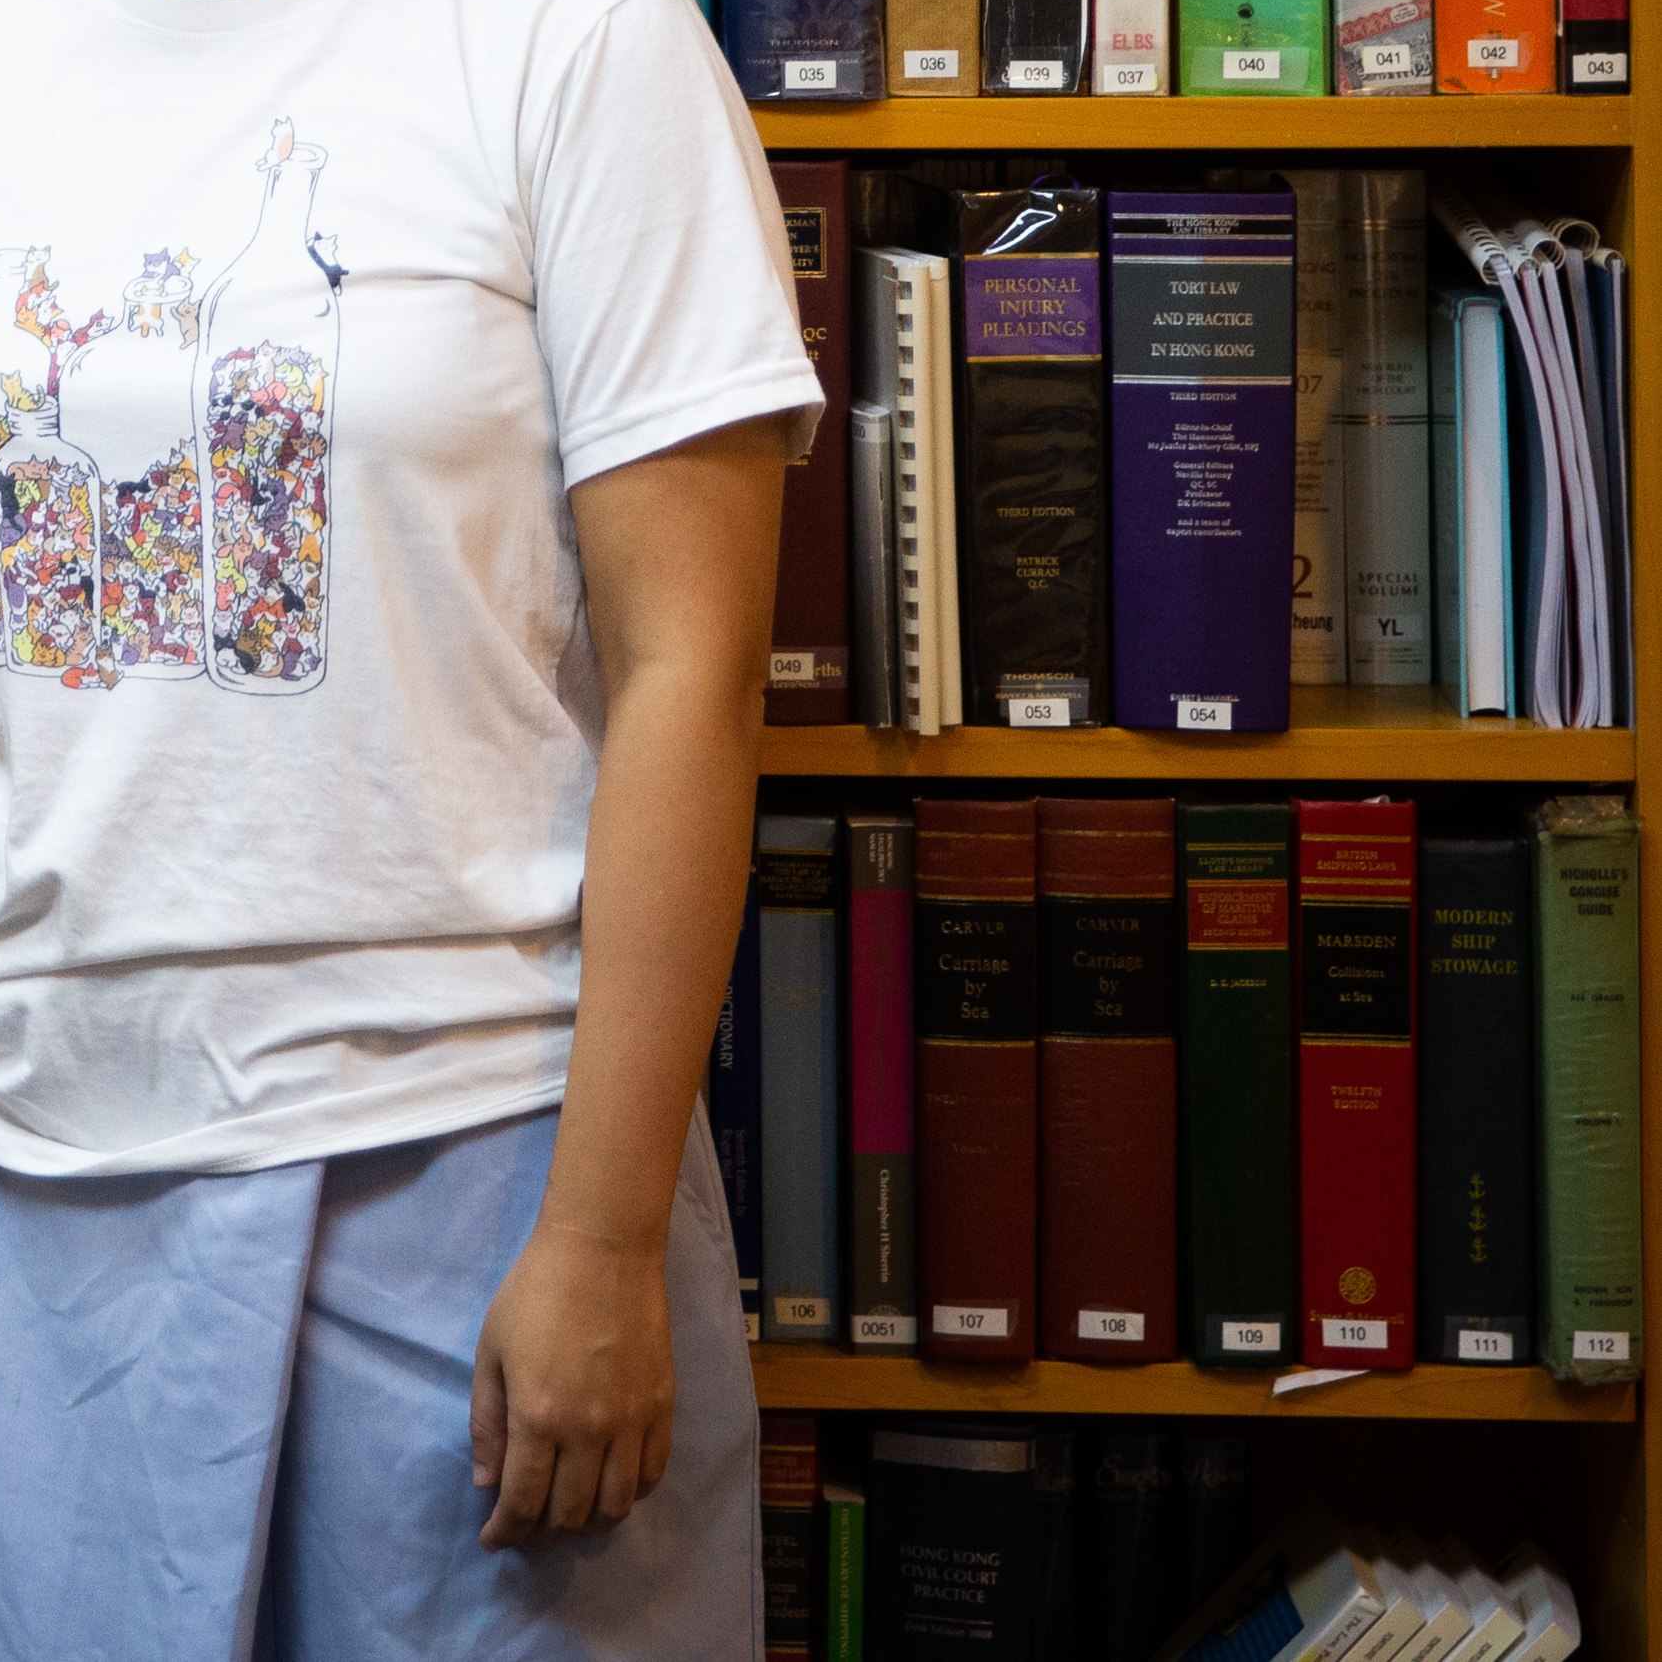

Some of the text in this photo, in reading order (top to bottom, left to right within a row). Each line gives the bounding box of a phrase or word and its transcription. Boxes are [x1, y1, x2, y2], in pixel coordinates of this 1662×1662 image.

[1480, 45, 1507, 61] 042
[1238, 57, 1266, 72] 040
[798, 67, 826, 82] 035
[1023, 66, 1051, 81] 039
[984, 277, 1081, 295] PERSONAL
[999, 298, 1067, 318] INJURY
[982, 320, 1086, 339] PLEADINGS
[1377, 618, 1404, 637] YL
[1024, 705, 1052, 720] 053
[1189, 707, 1217, 722] 054
[1434, 908, 1513, 926] MODERN
[1451, 933, 1497, 950] SHIP
[1431, 958, 1518, 975] STOWAGE
[790, 1304, 817, 1319] 106
[860, 1321, 895, 1337] 0051
[958, 1313, 985, 1329] 107
[1237, 1329, 1264, 1345] 109
[1340, 1326, 1367, 1342] 110
[1588, 1337, 1615, 1354] 112
